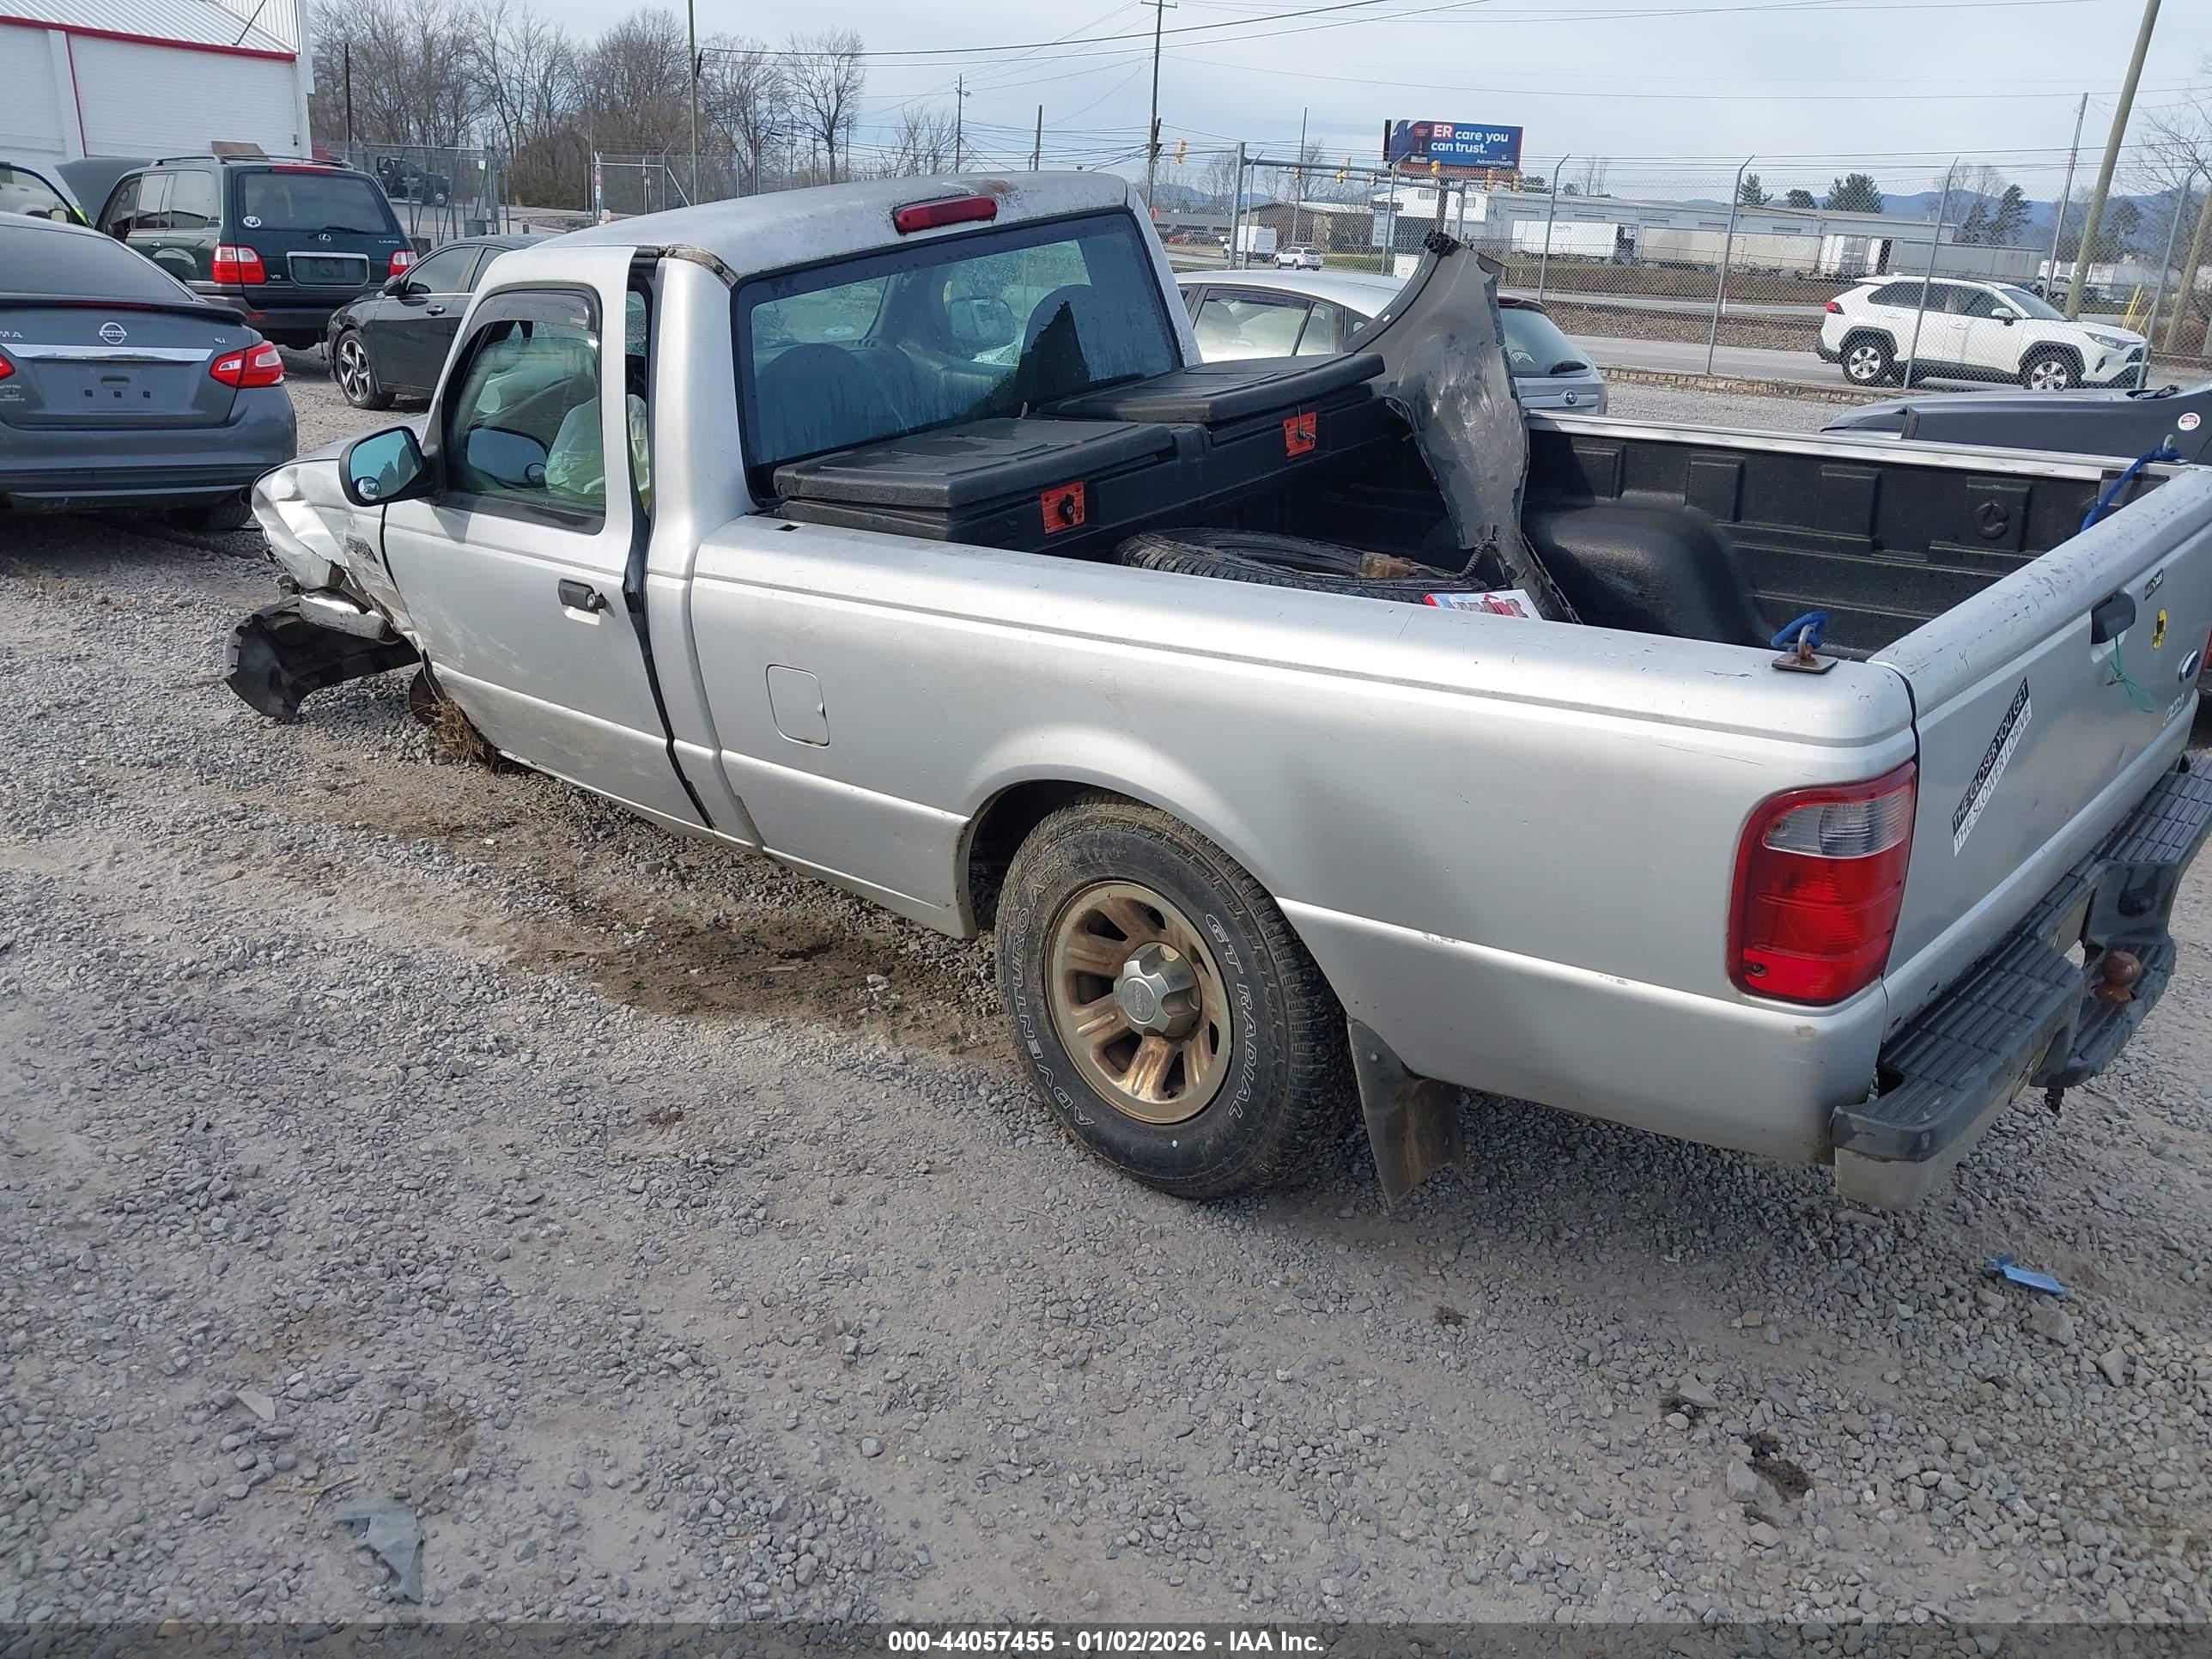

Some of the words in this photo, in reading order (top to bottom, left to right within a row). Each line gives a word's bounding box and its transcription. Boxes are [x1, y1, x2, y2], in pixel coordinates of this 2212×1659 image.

[1431, 142, 1453, 152] can
[1455, 143, 1487, 154] trust.
[1433, 125, 1453, 138] ER
[1455, 131, 1483, 140] care
[1486, 132, 1509, 144] you
[1953, 796, 1970, 830] THE
[1969, 742, 1998, 799] CLOSER
[1996, 714, 2013, 744] YOU
[2013, 680, 2028, 715] GET
[1955, 815, 1972, 849] THE
[1972, 756, 2004, 816] SLOWER
[2008, 702, 2031, 750] DRIVE
[1012, 908, 1095, 1125] ADVENTURO
[1205, 914, 1244, 975] GT
[1228, 982, 1258, 1120] RADIAL
